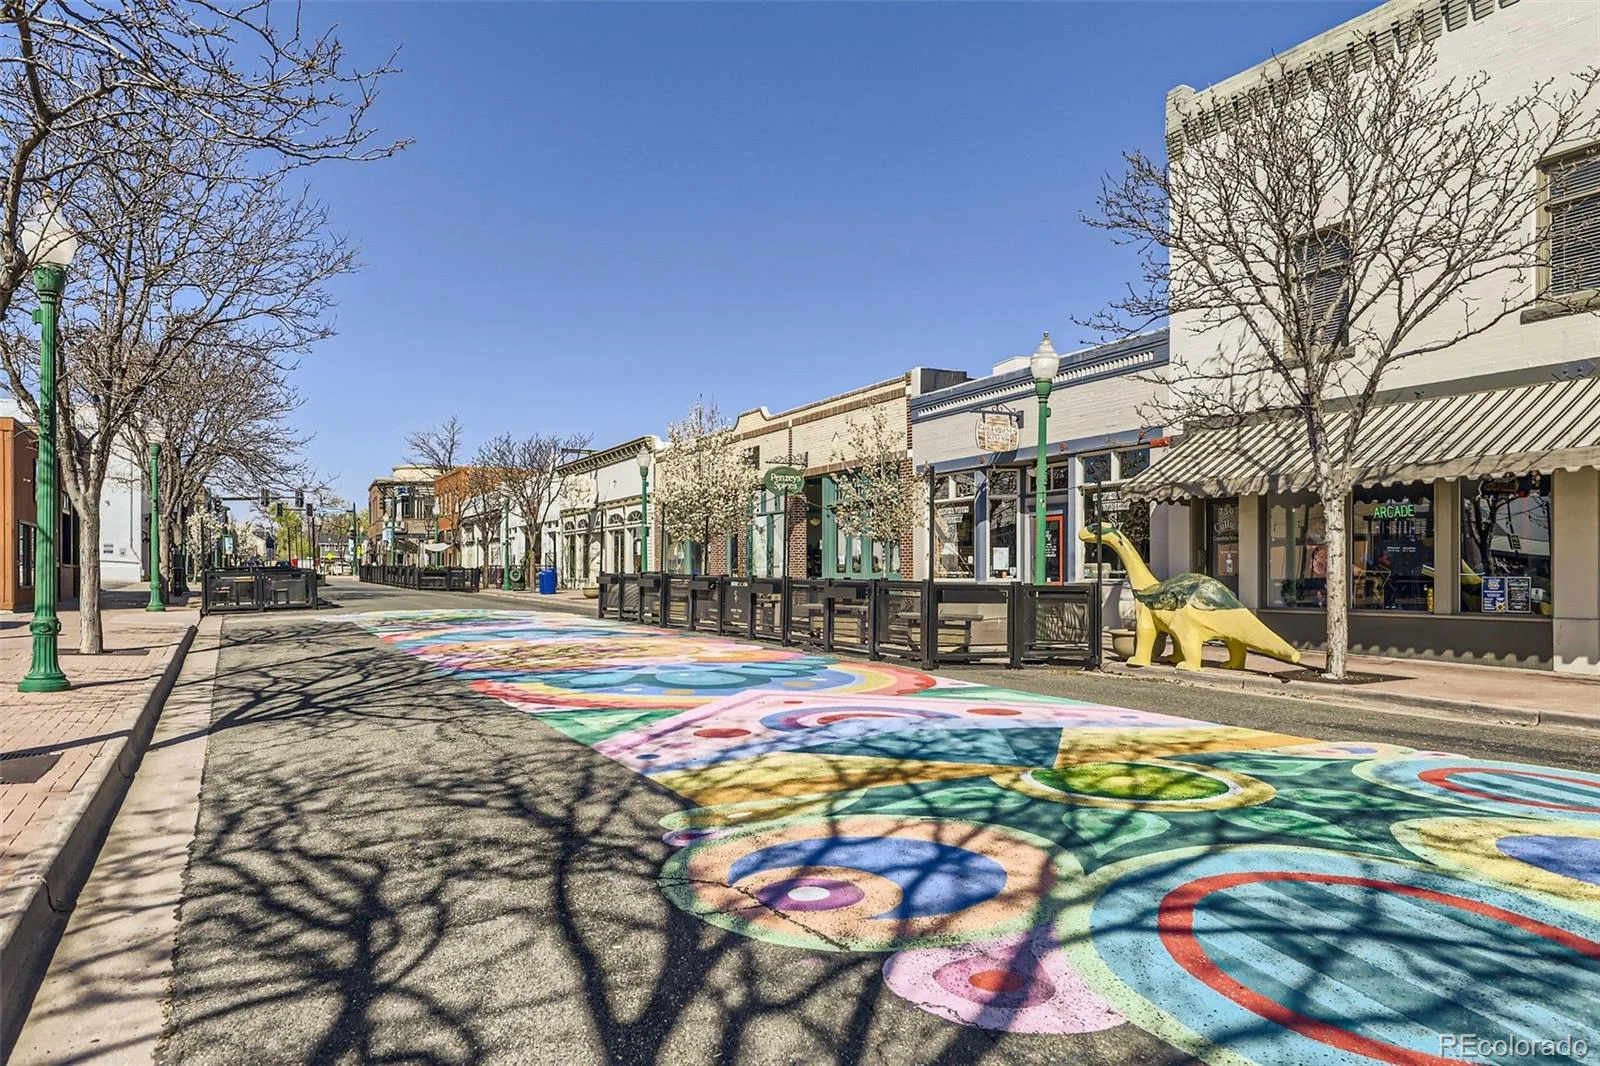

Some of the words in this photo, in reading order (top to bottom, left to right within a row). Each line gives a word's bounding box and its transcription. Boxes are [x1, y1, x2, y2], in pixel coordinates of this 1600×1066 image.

[771, 473, 801, 483] Penzeys
[774, 481, 797, 491] Spices
[1374, 505, 1414, 518] ARCADE
